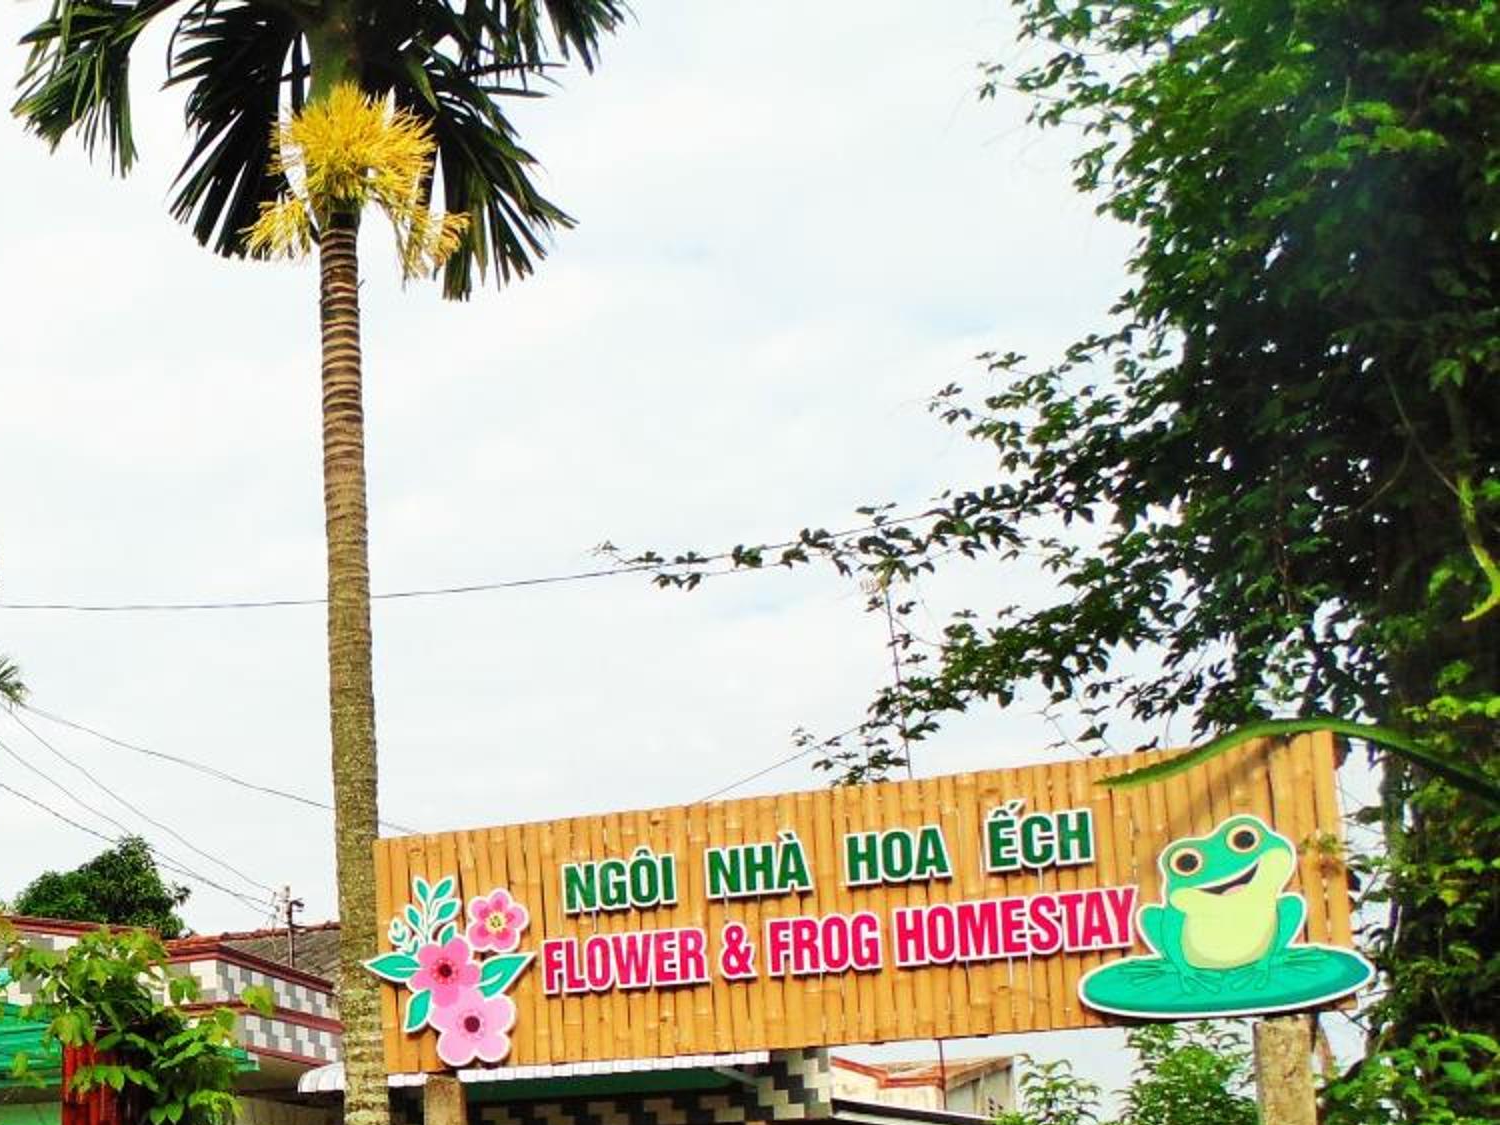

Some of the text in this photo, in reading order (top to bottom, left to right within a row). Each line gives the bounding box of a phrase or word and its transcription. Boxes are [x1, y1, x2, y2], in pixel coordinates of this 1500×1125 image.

[563, 800, 1093, 910] NGÔI NHÀ HOA ẾCH
[543, 888, 1134, 992] FLOWER & FROG HOMESTAY
